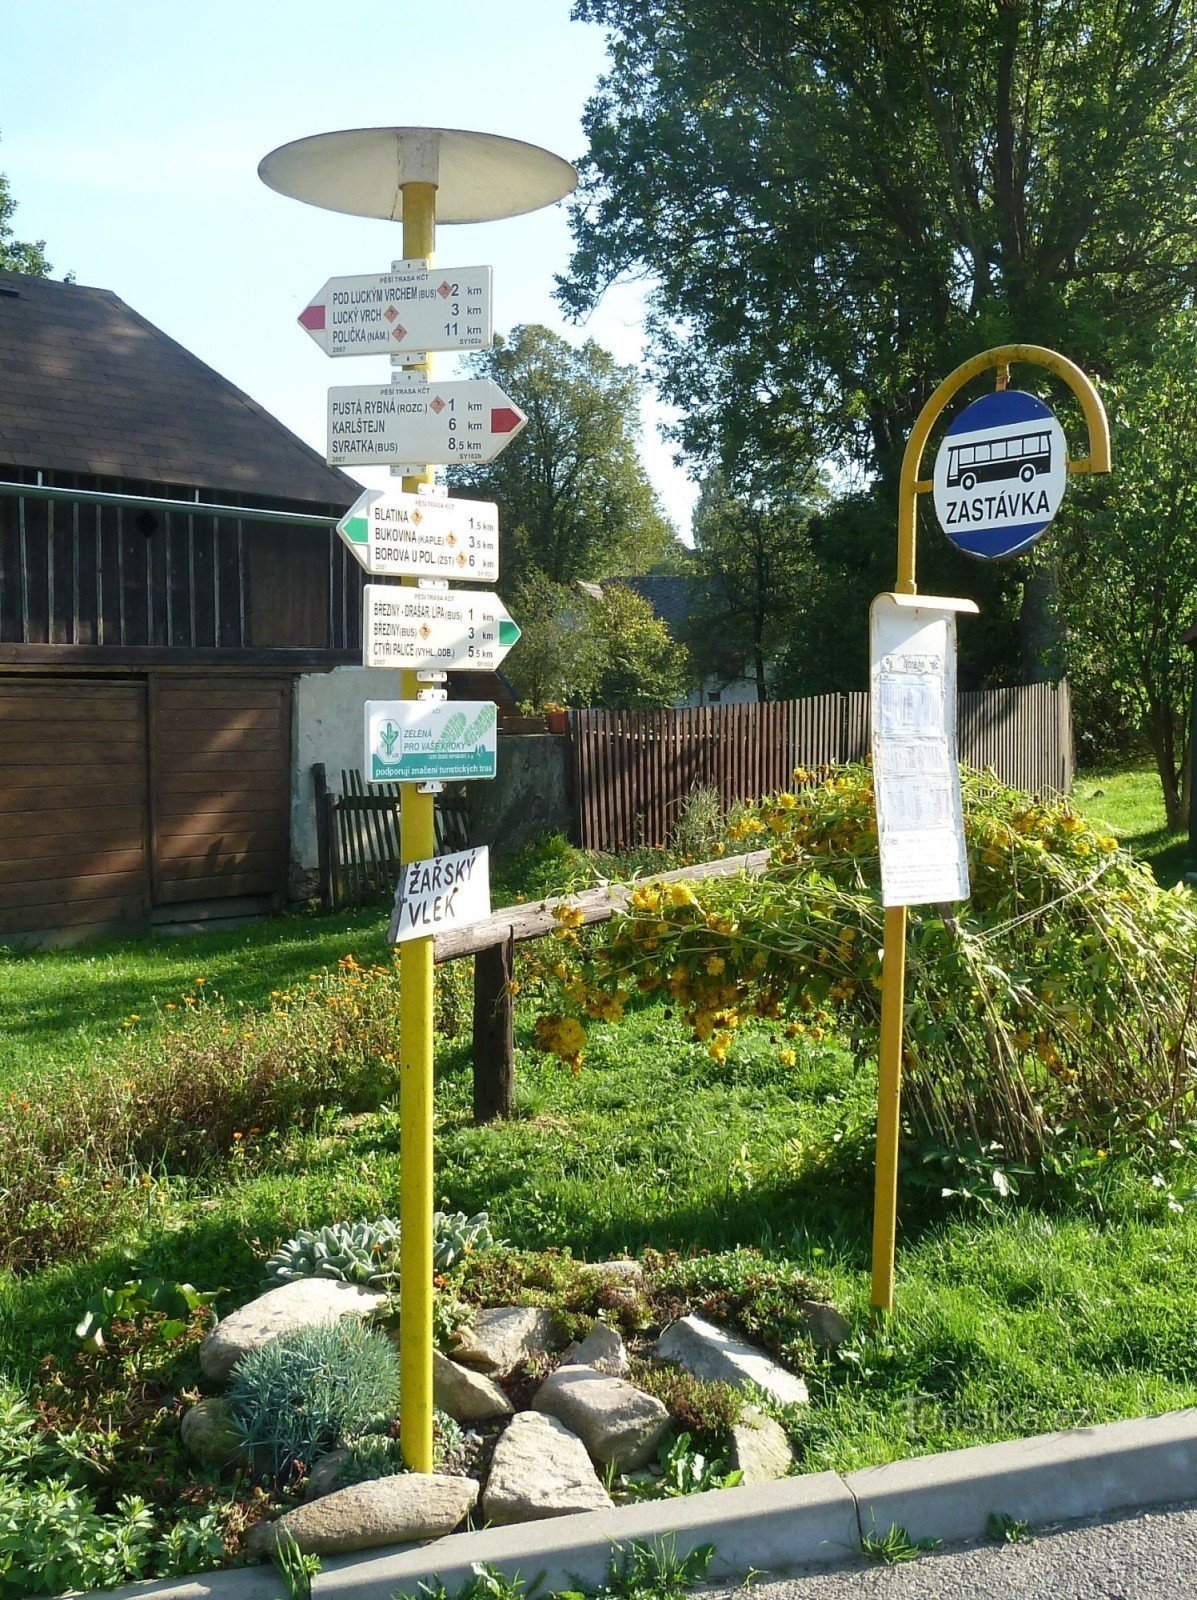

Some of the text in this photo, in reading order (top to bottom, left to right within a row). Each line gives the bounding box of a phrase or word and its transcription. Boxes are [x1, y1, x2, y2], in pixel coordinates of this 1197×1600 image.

[333, 284, 482, 305] POD LUCKÝM VRCHEM (BUS) 2 km
[333, 303, 482, 324] LUCKÝ VRCH 3 km
[333, 322, 482, 344] POLIČKA (NÁM.) 11 km
[332, 398, 362, 416] PUSTÁ
[364, 398, 396, 414] RYBNÁ
[448, 398, 454, 412] 1
[468, 402, 482, 410] km
[332, 418, 482, 434] KARLŠTEJN 6 km
[332, 437, 482, 454] SVRATKA (BUS) 8,5 km
[946, 490, 1050, 524] ZASTÁVKA
[374, 508, 409, 522] BLATINA
[483, 523, 494, 531] km
[376, 528, 416, 542] BUKOVINA
[418, 535, 444, 547] (KAPLE)
[483, 541, 494, 550] km
[412, 550, 418, 562] U
[469, 555, 475, 566] 6
[483, 560, 494, 568] km
[374, 600, 400, 616] BŘEZINY
[445, 610, 462, 621] (BUS)
[468, 608, 473, 620] 1
[482, 613, 494, 622] km
[374, 620, 494, 640] BŘEZINY (BUS) 3 km
[394, 642, 414, 656] PALICE
[468, 646, 480, 659] 5,5
[482, 650, 493, 658] km
[404, 728, 432, 738] ZELENÁ
[404, 740, 465, 751] PRO VAŠE KROKY
[412, 765, 438, 775] značení
[439, 764, 478, 774] turistických
[408, 849, 476, 894] ŽAŘSKÝ
[408, 892, 456, 927] VLEK
